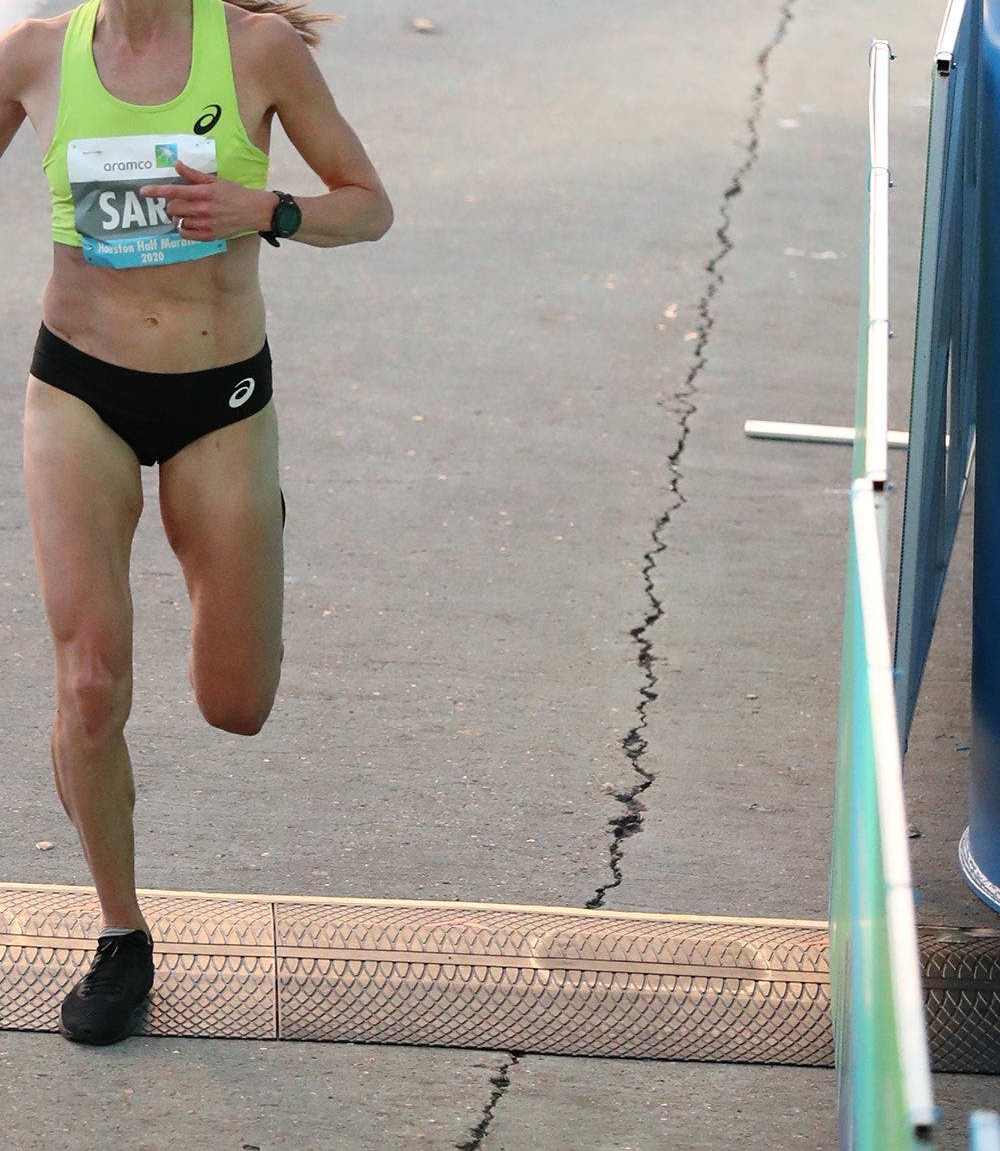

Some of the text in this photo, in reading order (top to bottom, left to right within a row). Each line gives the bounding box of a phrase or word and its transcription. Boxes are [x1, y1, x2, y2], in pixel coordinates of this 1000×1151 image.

[103, 160, 153, 172] aramco
[98, 242, 134, 254] Houston
[137, 238, 157, 251] Half
[141, 251, 165, 263] 2020
